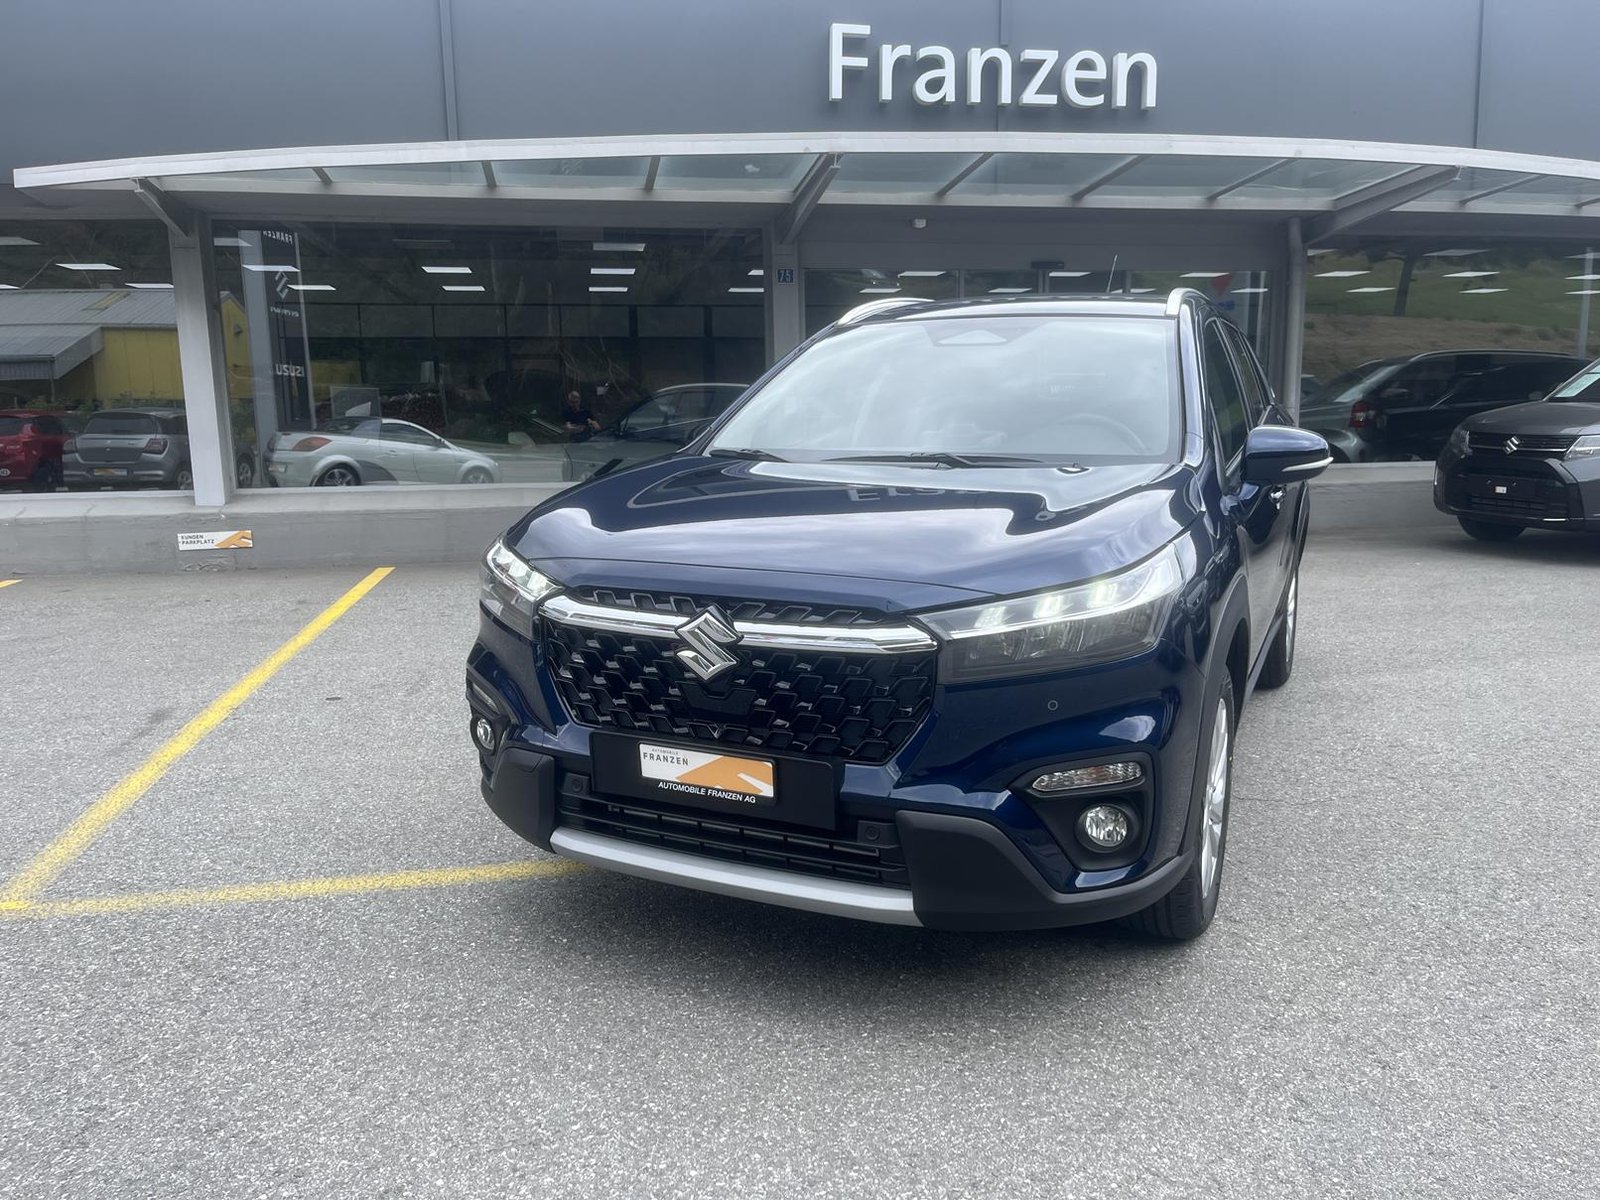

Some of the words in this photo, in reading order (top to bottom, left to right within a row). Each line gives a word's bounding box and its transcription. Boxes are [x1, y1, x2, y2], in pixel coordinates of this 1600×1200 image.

[829, 22, 1158, 110] Franzen
[779, 269, 792, 283] 75
[643, 752, 689, 766] FRANZEN
[658, 781, 706, 795] AUTOMOBILE
[707, 789, 743, 801] FRANZEN
[744, 795, 756, 804] AG
